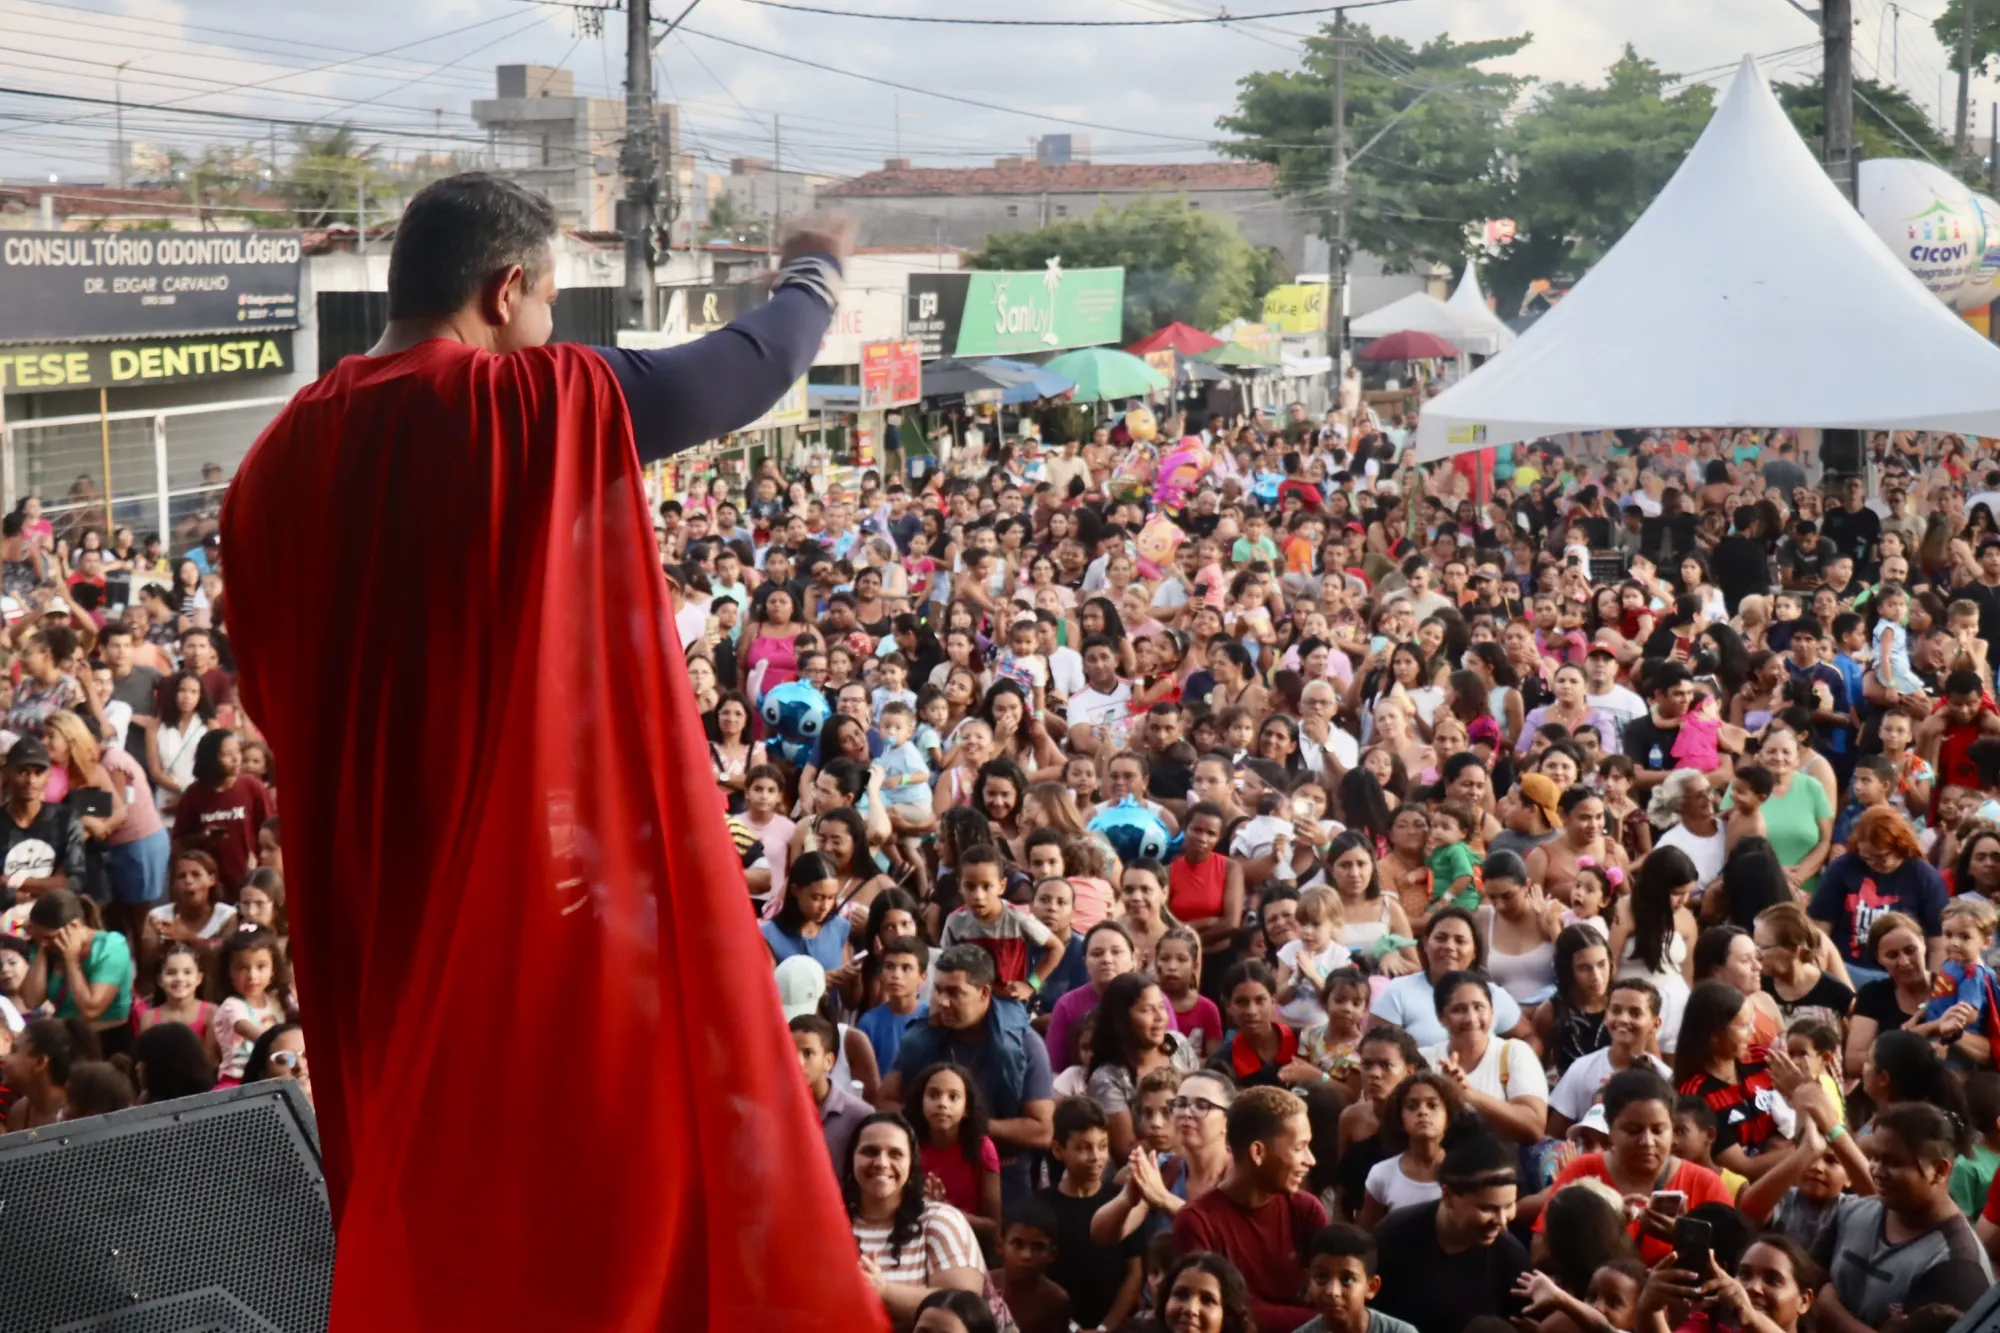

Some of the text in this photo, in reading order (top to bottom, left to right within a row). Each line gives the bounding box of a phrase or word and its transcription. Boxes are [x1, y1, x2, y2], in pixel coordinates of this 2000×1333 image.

[5, 234, 300, 266] CONSULTÓRIO ODONTOLÓGICO
[84, 275, 229, 294] DR. EDGAR CARVALHO
[111, 340, 283, 381] DENTISTA
